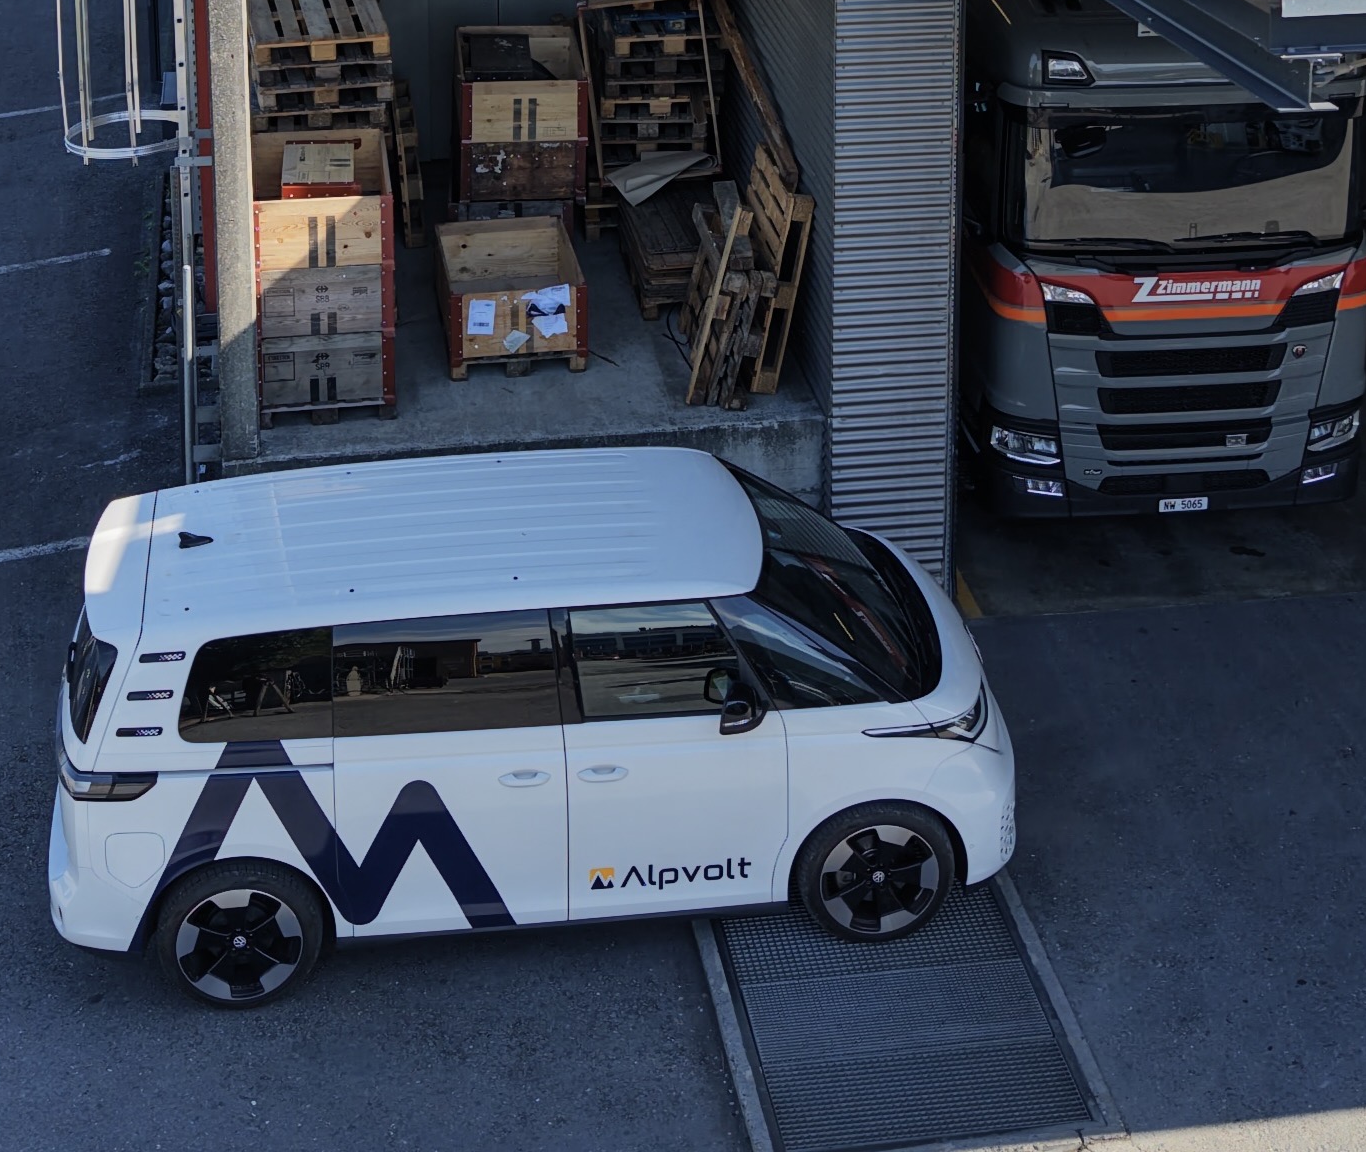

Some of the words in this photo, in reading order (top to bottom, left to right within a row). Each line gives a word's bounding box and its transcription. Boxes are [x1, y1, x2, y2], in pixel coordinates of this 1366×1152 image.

[1156, 279, 1262, 295] Zimmermann
[1163, 501, 1177, 511] NW
[1180, 499, 1203, 510] 5065
[620, 857, 752, 890] Alpvolt
